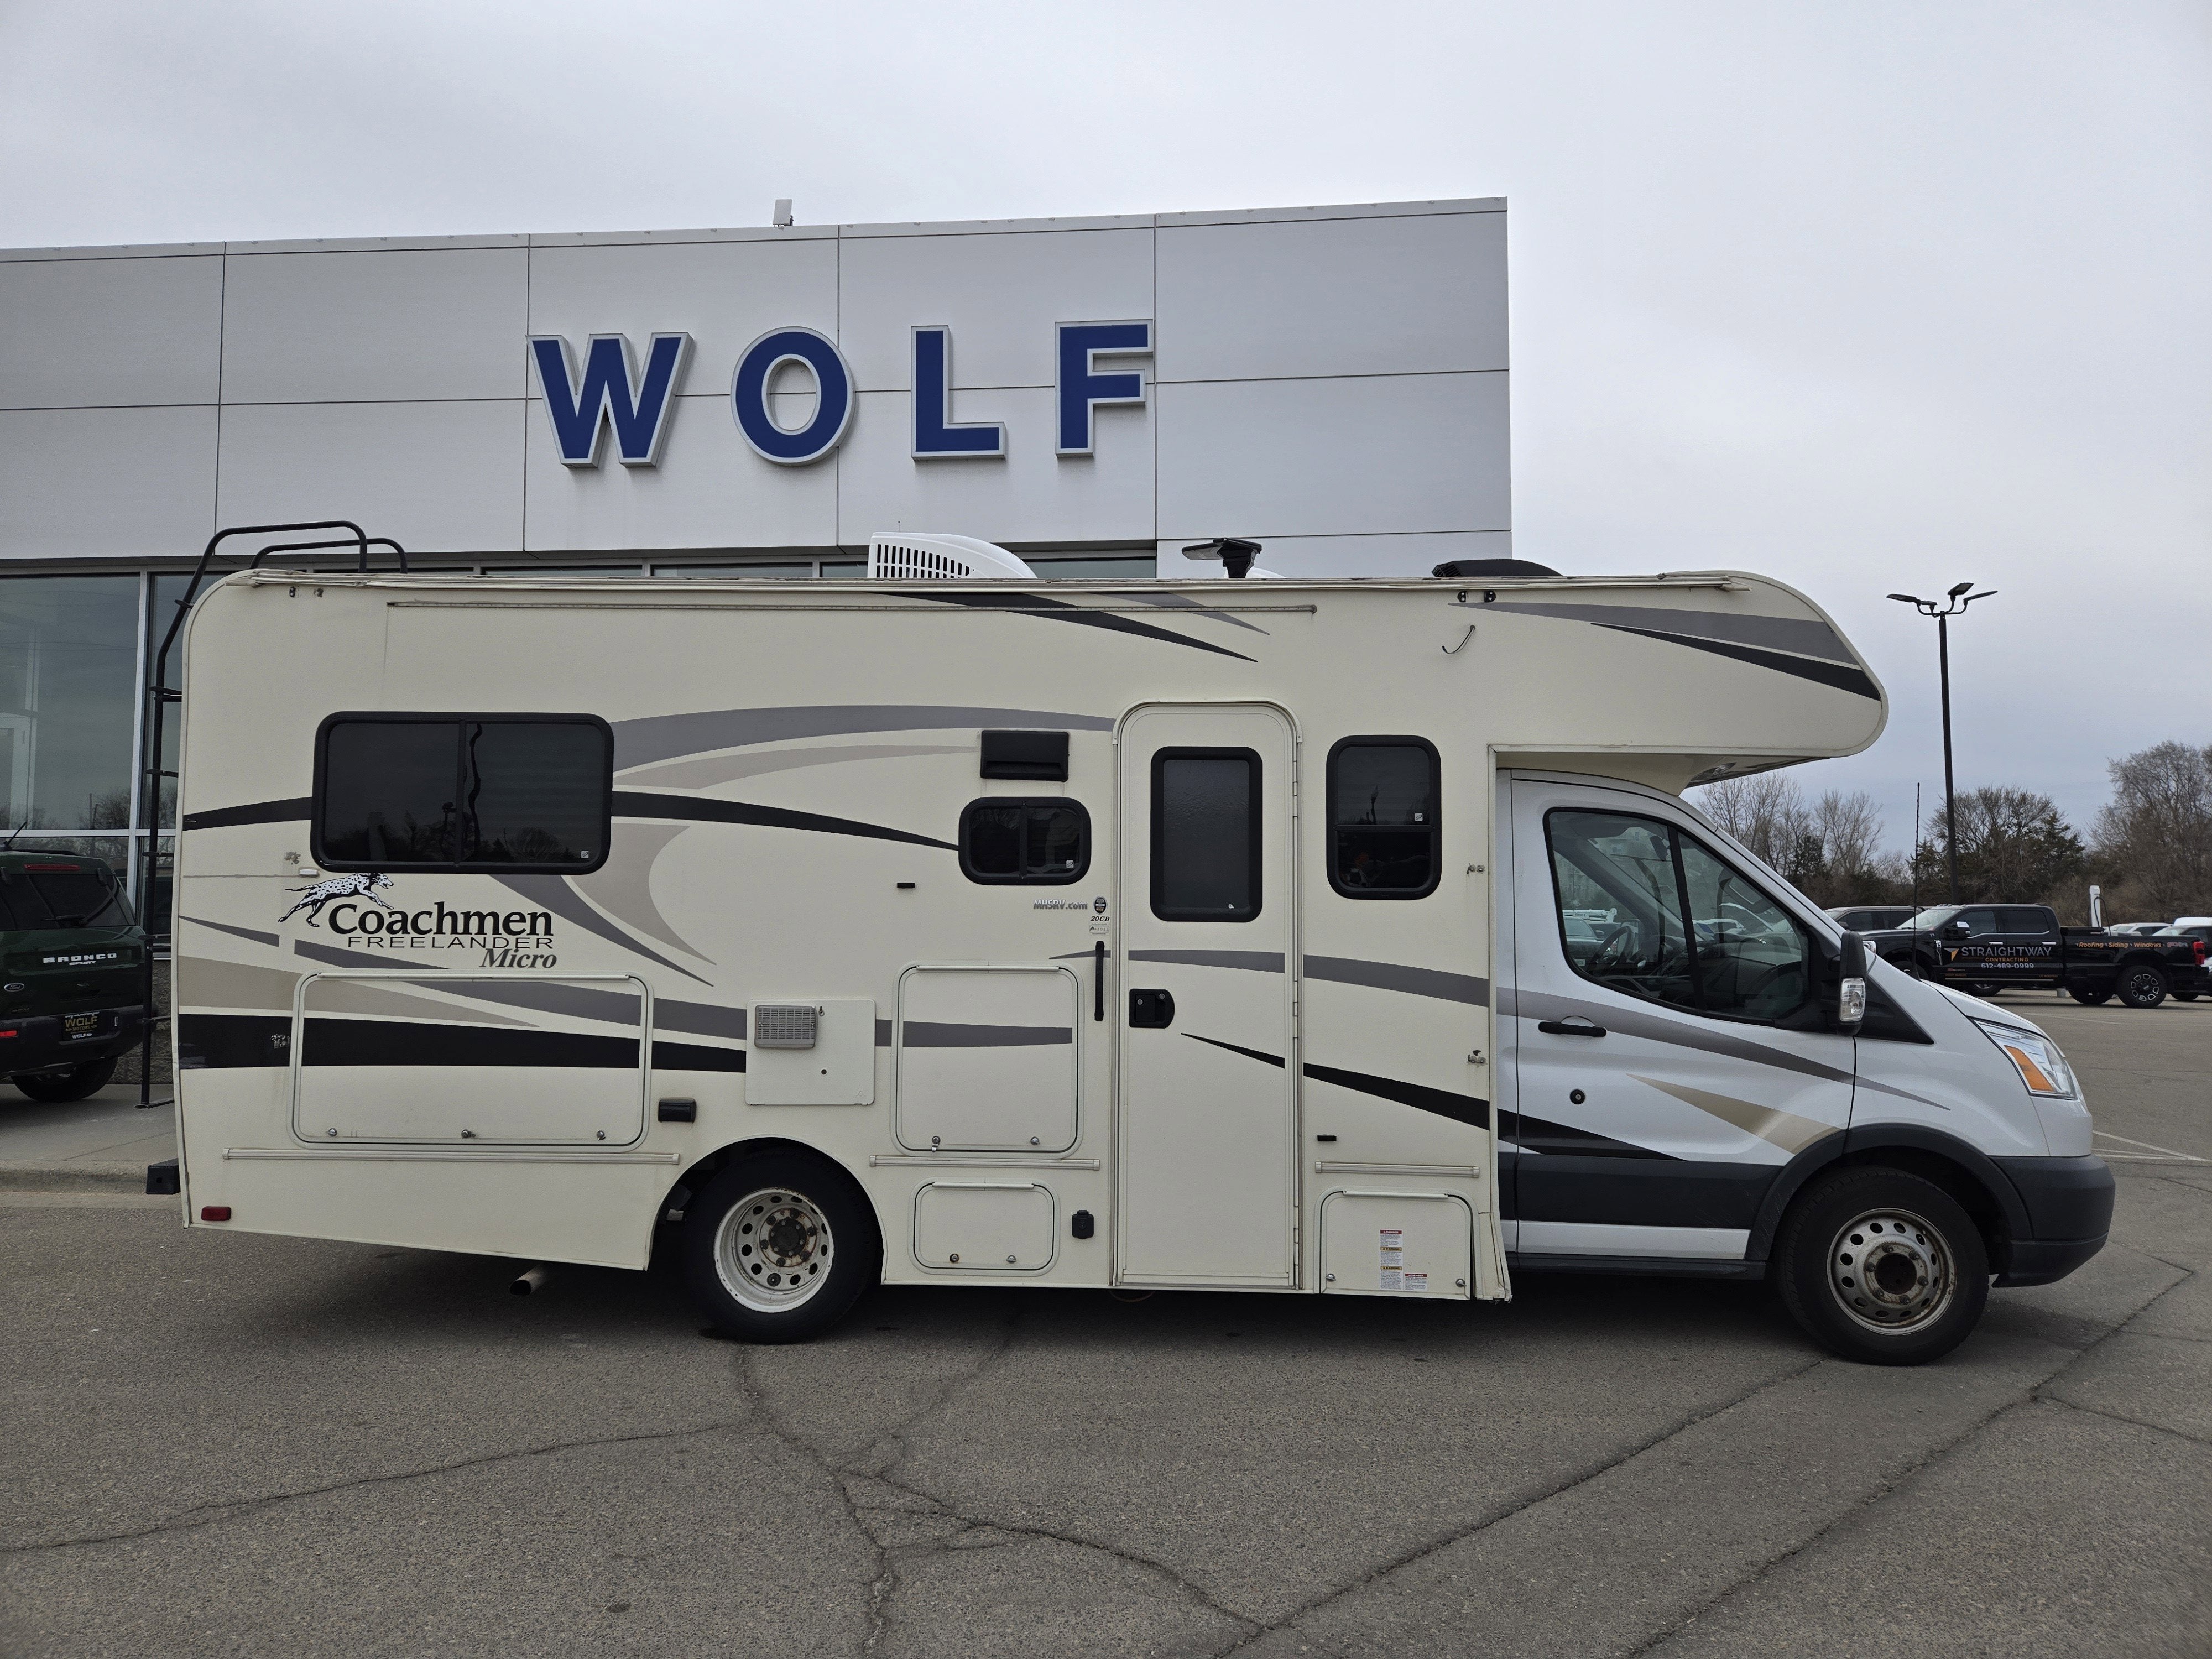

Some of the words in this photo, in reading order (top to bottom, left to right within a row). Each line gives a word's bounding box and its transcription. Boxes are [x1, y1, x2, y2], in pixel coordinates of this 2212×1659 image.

[526, 319, 1154, 468] WOLF
[1033, 899, 1088, 910] MHSRV.com
[328, 901, 554, 936] Coachmen
[348, 936, 553, 949] FREELANDER
[43, 953, 117, 963] BRONCO
[1961, 947, 2052, 957] STRAIGHTWAY
[479, 948, 557, 969] Micro
[65, 1016, 98, 1027] WOLF
